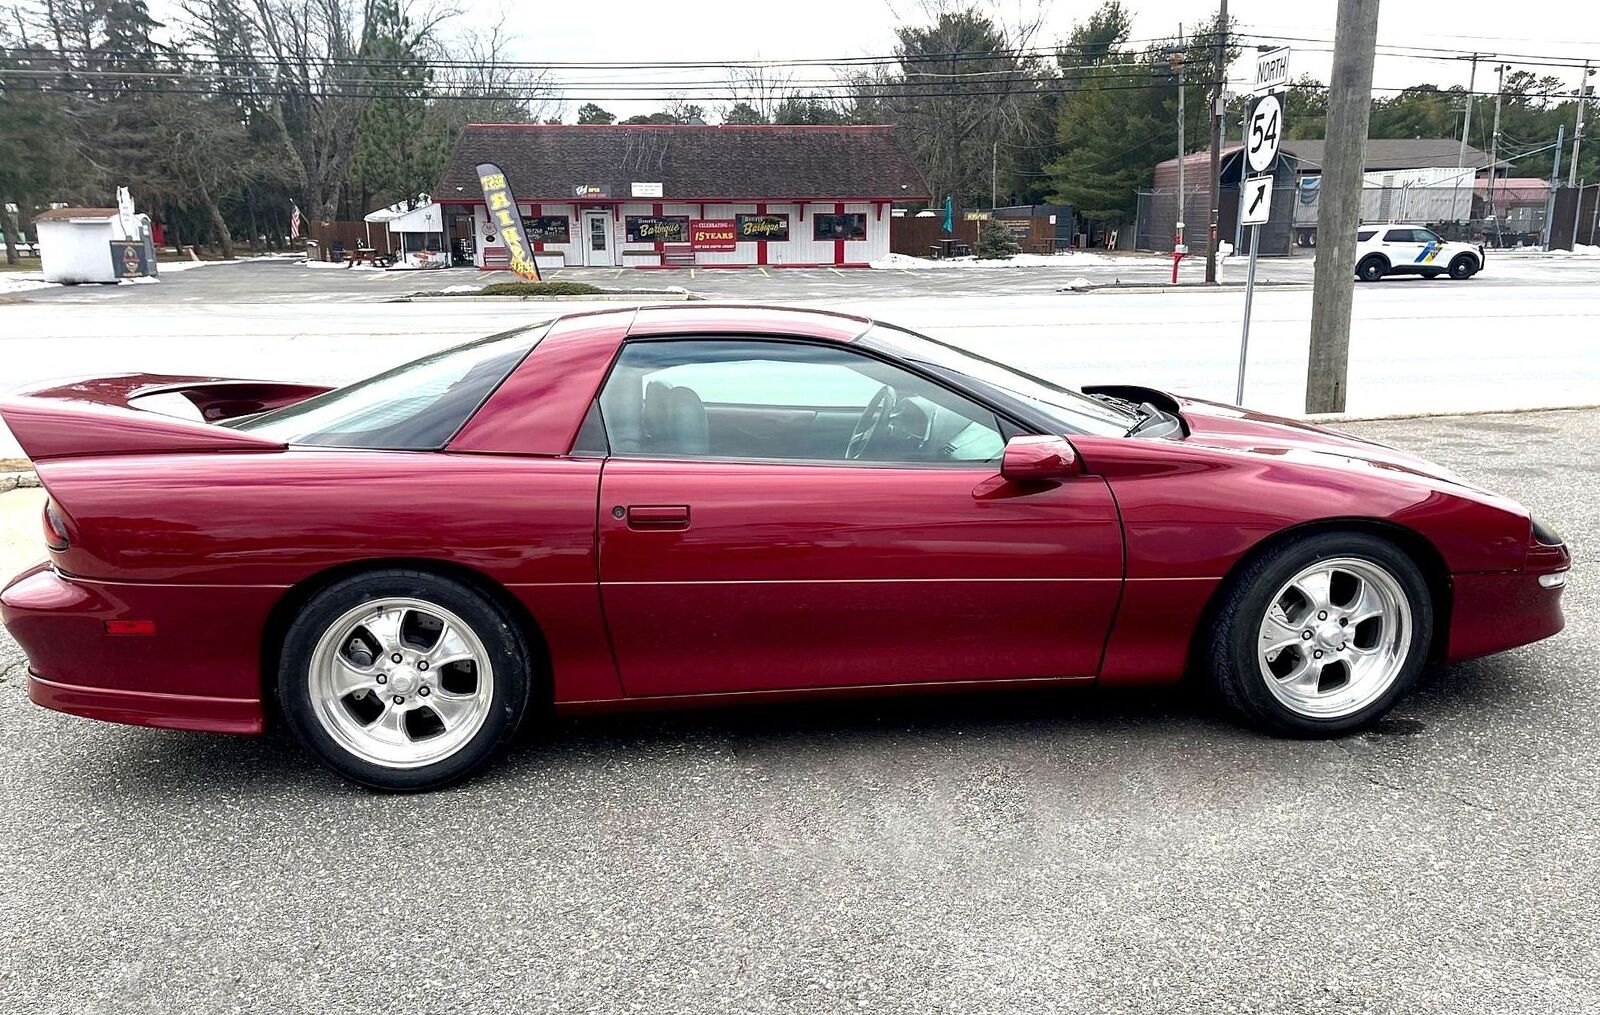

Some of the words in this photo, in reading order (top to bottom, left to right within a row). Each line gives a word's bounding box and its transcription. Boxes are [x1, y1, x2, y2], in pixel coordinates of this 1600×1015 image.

[1257, 56, 1287, 84] NORTH
[1250, 109, 1279, 154] 54
[695, 231, 705, 241] 15
[704, 231, 734, 240] YEARS
